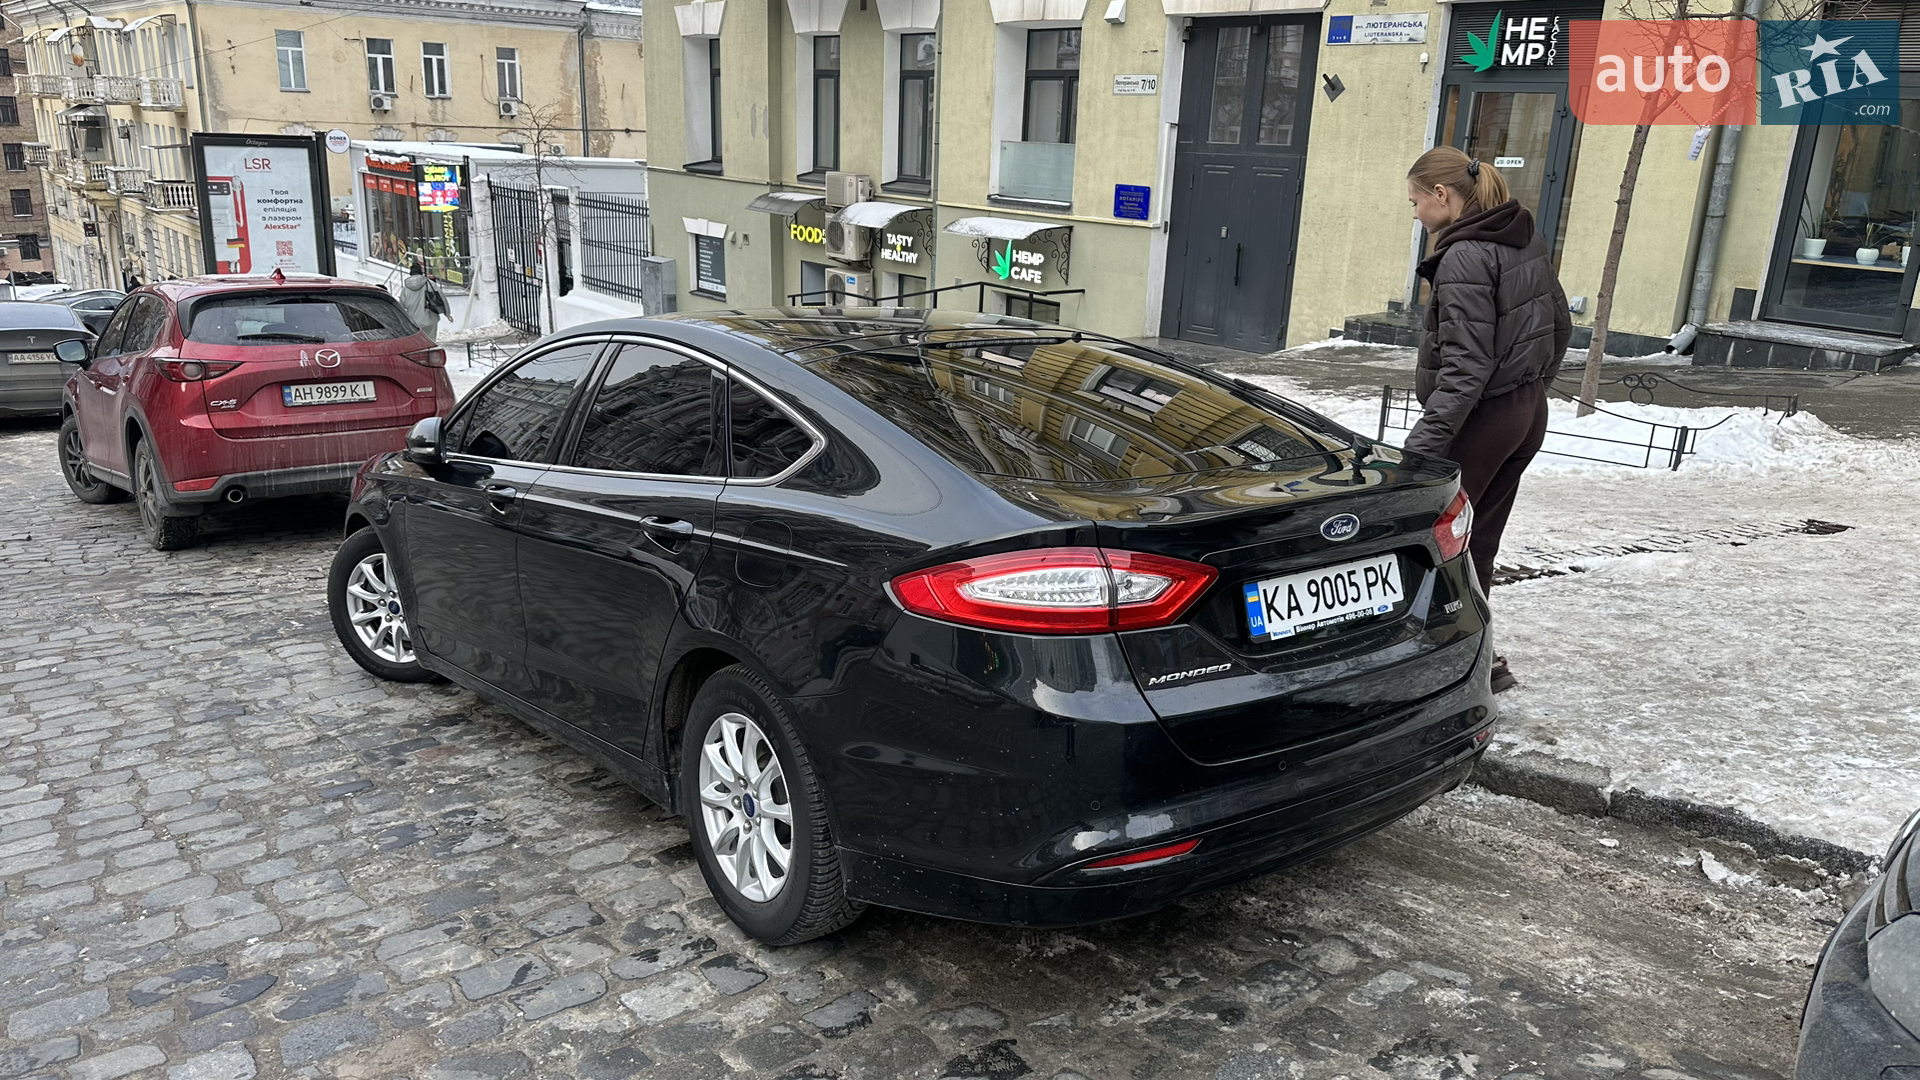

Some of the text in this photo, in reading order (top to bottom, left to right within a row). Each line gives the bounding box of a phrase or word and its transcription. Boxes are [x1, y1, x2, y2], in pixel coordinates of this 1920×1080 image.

[1365, 21, 1423, 29] ЛЮТЕРАНСЬКА
[1505, 17, 1548, 41] HE
[1547, 16, 1560, 66] FACTOR
[1501, 42, 1545, 66] MP
[1141, 79, 1156, 91] 7/10
[244, 158, 272, 170] LSR
[269, 188, 289, 196] Твоя
[257, 197, 303, 205] комфортна
[790, 223, 822, 244] FOOD
[886, 233, 913, 247] TASTY
[881, 248, 919, 264] HEALTHY
[1012, 249, 1045, 265] HEMP
[1010, 266, 1043, 283] CAFE
[294, 387, 314, 401] AH
[316, 385, 347, 399] 9899
[350, 384, 367, 397] KI
[1330, 519, 1352, 536] Ford
[1250, 562, 1397, 628] UA KA 9005 PK
[1148, 663, 1232, 686] MONDEO
